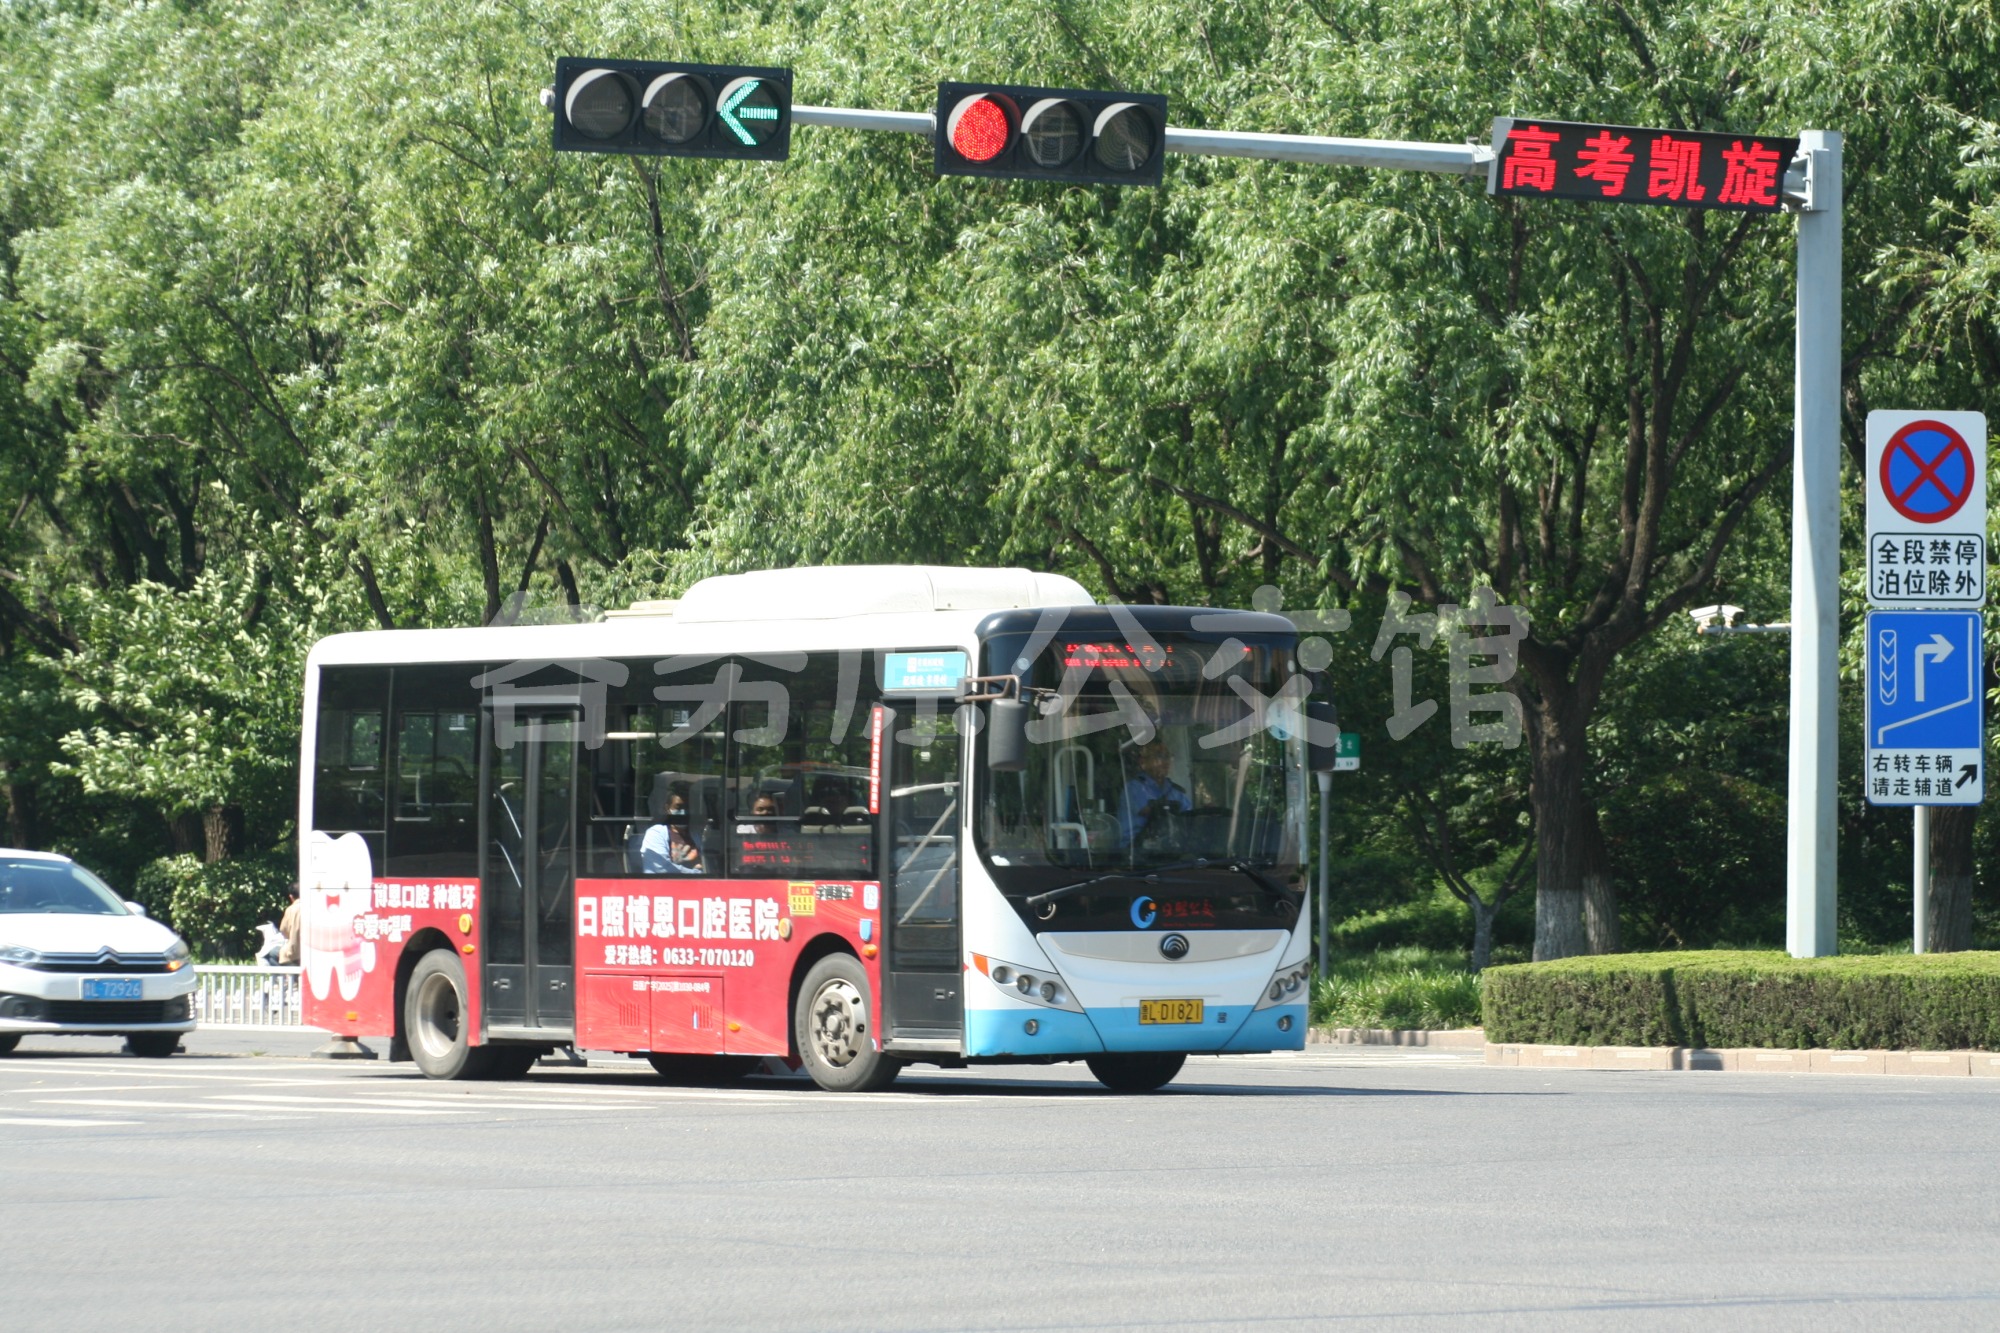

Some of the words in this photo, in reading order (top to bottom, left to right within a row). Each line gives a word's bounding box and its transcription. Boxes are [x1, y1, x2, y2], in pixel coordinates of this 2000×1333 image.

[1502, 125, 1781, 206] 高考凯旋
[1877, 539, 1979, 566] 全段禁停
[1877, 569, 1978, 597] 泊位除外
[1872, 753, 1954, 775] 右转车辆
[1872, 776, 1954, 798] 请走辅道
[373, 882, 430, 909] 博恩口腔
[433, 884, 476, 910] 种植牙
[577, 895, 780, 941] 日照博恩口腔医院
